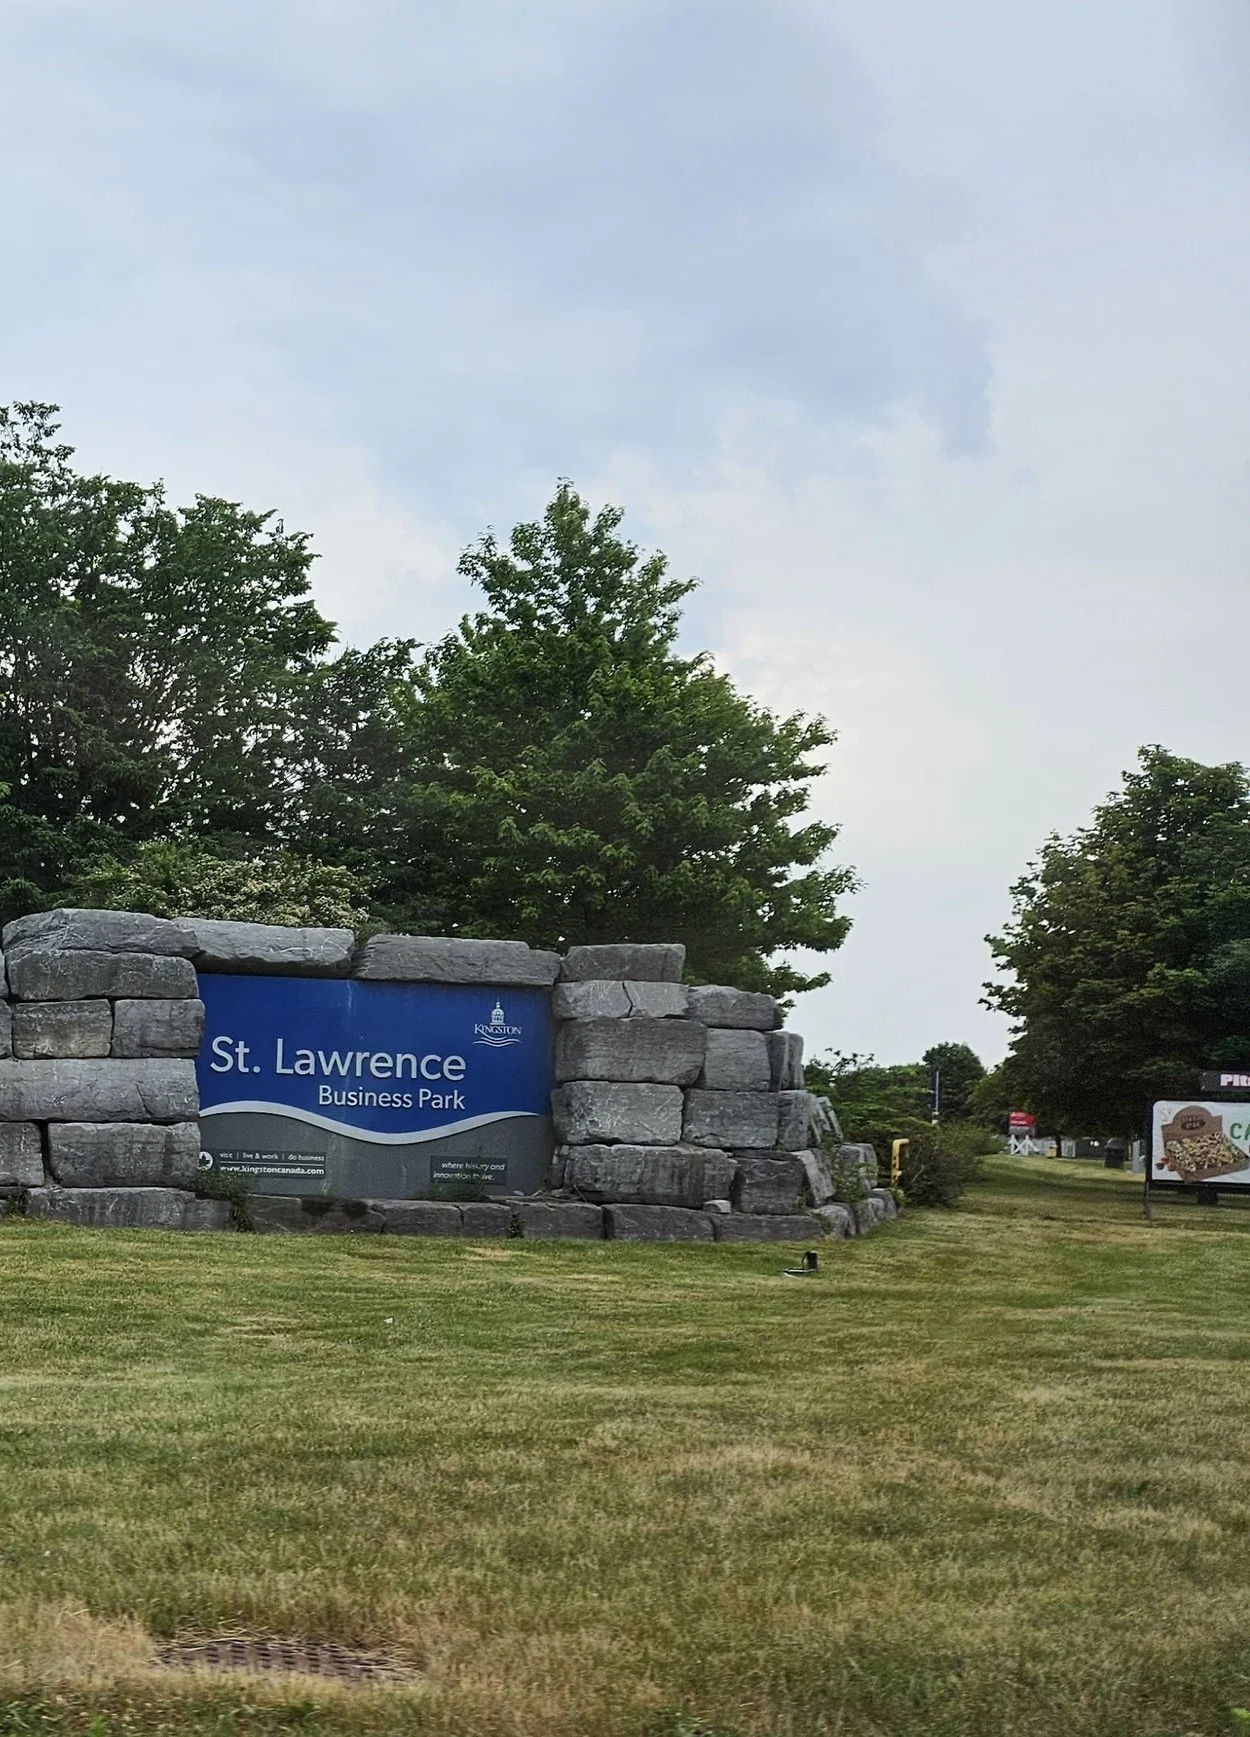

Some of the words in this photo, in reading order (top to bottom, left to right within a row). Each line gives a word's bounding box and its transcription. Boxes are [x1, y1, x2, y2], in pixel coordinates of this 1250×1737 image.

[474, 1023, 522, 1035] KINGSTON
[210, 1035, 261, 1074] St.
[275, 1038, 467, 1081] Lawrence
[318, 1085, 413, 1108] Business
[418, 1088, 466, 1110] Park
